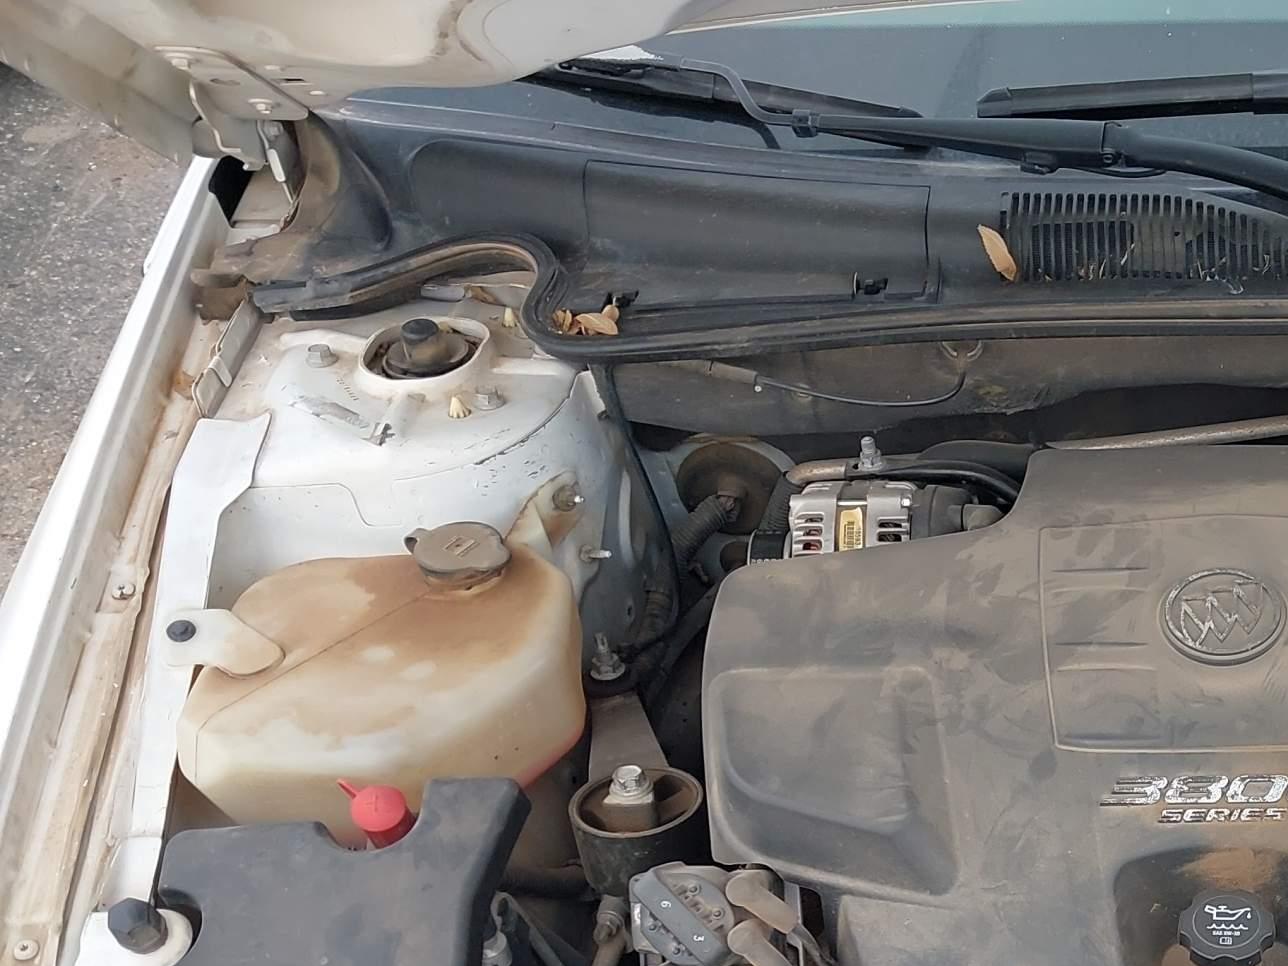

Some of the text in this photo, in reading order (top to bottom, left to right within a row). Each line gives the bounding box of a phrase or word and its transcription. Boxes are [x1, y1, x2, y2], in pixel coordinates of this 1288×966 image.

[1158, 808, 1287, 823] SERIES
[661, 900, 671, 909] 6
[693, 934, 704, 943] 3
